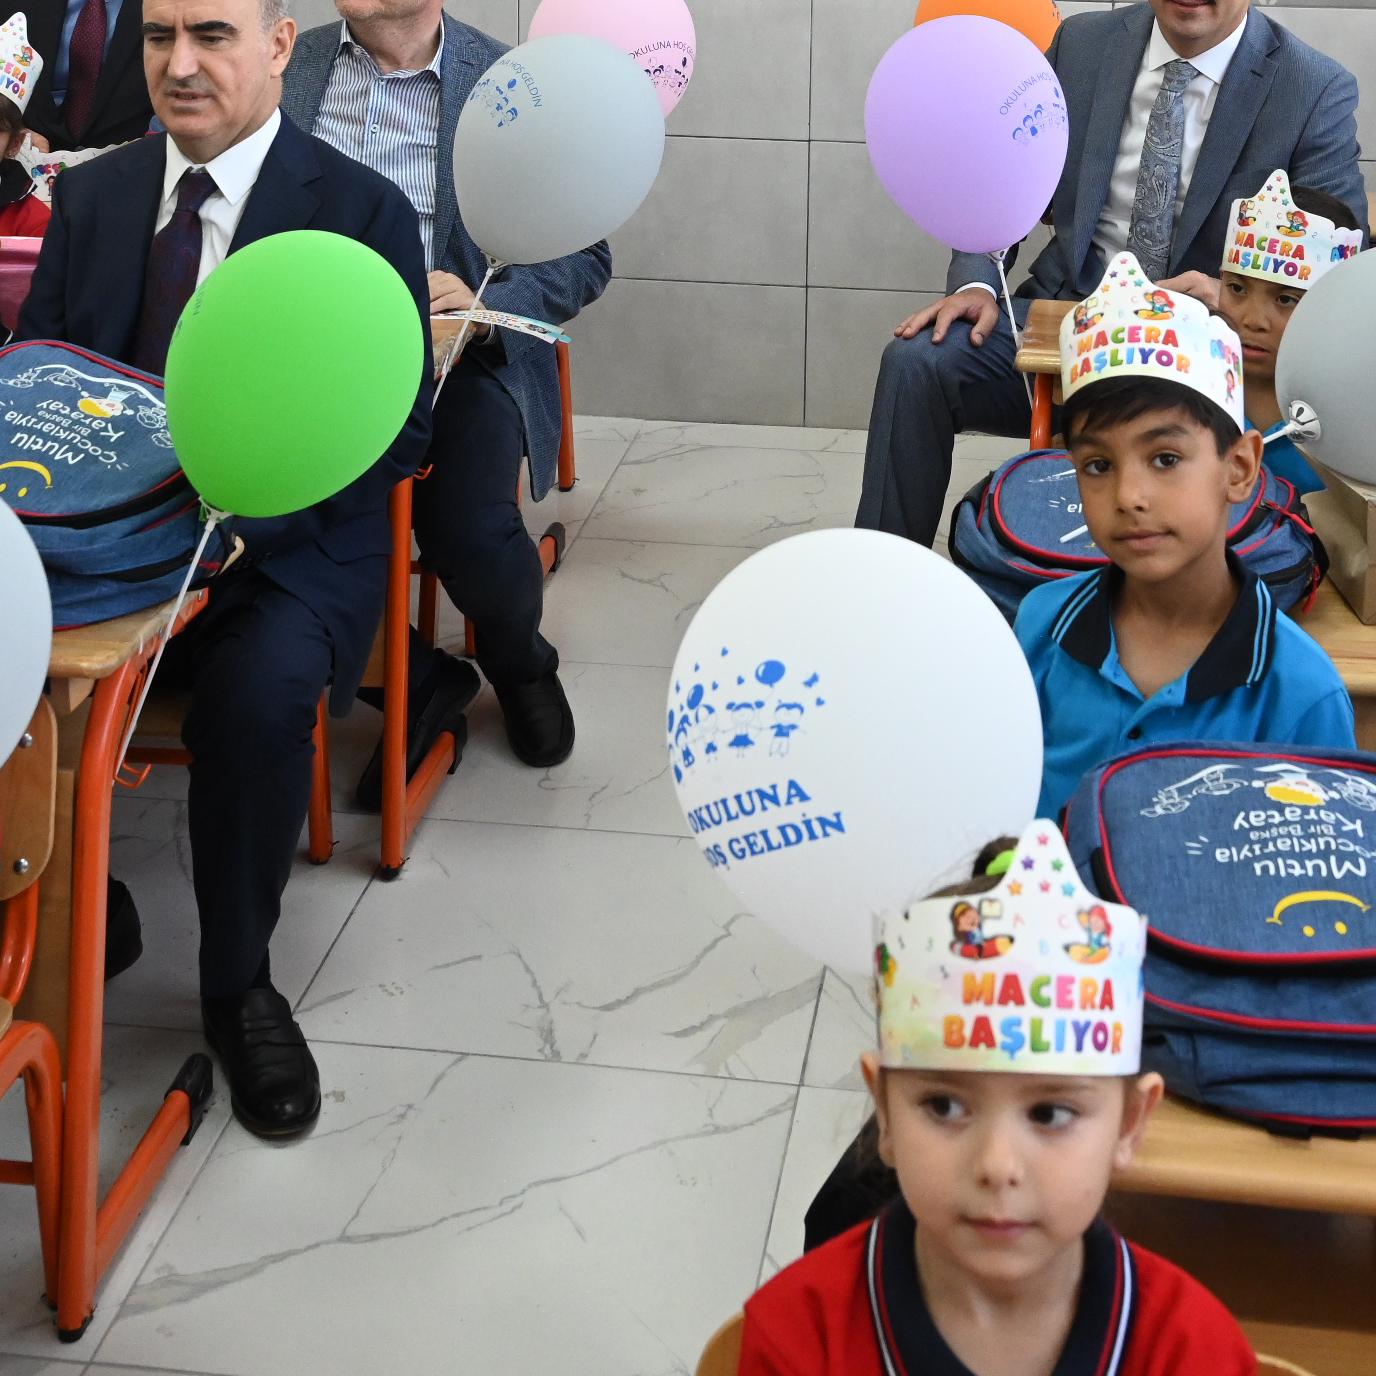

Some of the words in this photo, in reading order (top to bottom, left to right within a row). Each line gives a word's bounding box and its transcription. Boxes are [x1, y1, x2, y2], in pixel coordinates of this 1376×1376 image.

[1234, 230, 1305, 261] MACERA
[1227, 247, 1312, 281] BAŞLIYOR
[1077, 325, 1179, 357] MACERA
[1070, 347, 1192, 385] BAŞLIYOR
[36, 399, 125, 442] Karatay
[10, 432, 85, 465] Mutlu
[687, 779, 812, 835] OKULUNA
[1233, 806, 1364, 838] Karatay
[729, 811, 847, 862] GELDİN
[1253, 854, 1367, 880] Mutlu
[962, 972, 1115, 1011] MACERA
[942, 1014, 1123, 1061] BAŞLIYOR
